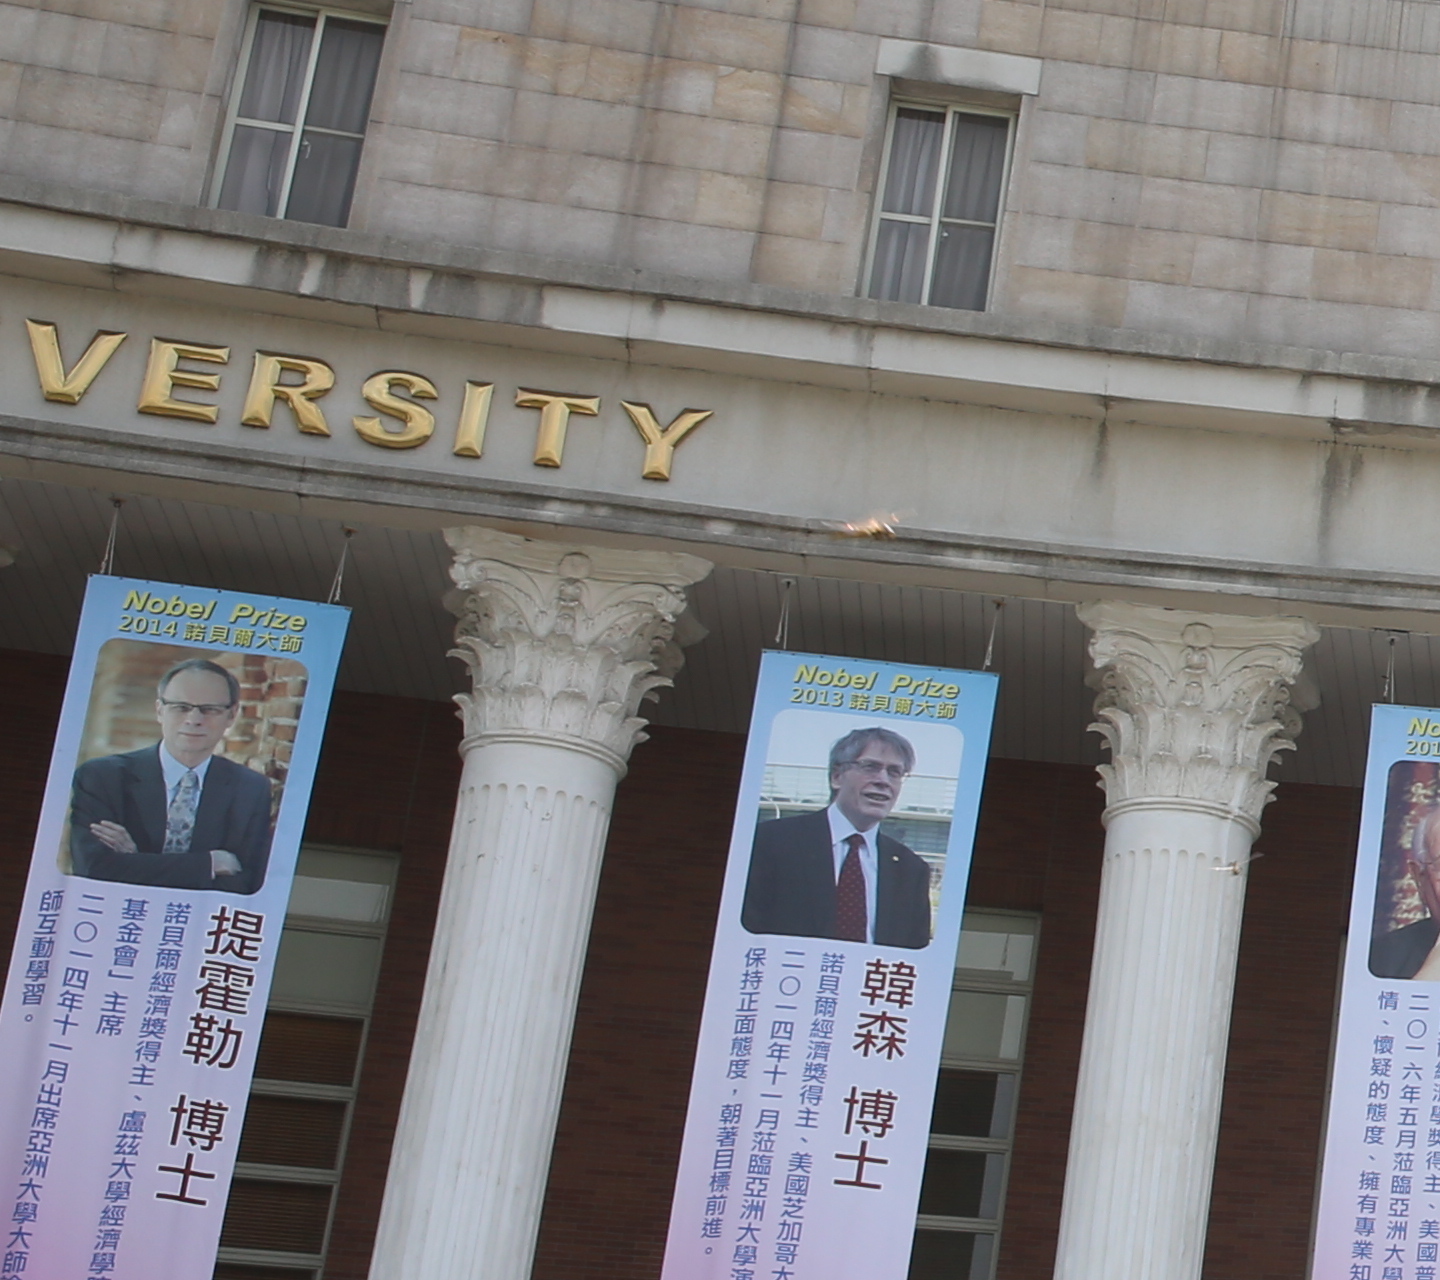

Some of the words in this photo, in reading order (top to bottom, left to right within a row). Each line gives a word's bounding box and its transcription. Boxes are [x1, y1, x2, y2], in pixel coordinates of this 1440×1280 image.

[25, 319, 714, 481] VERSITY
[118, 616, 178, 638] 2014
[182, 622, 303, 654] 諾貝爾大師
[122, 590, 216, 620] Nobel
[228, 604, 307, 632] Prize
[790, 688, 844, 707] 2013
[849, 692, 956, 719] 諾貝爾大師
[794, 664, 878, 690] Nobel
[890, 674, 960, 699] Prize
[182, 906, 265, 1070] 提霍勒
[853, 958, 916, 1060] 韓森
[155, 1094, 229, 1206] 博士
[834, 1086, 898, 1190] 博士
